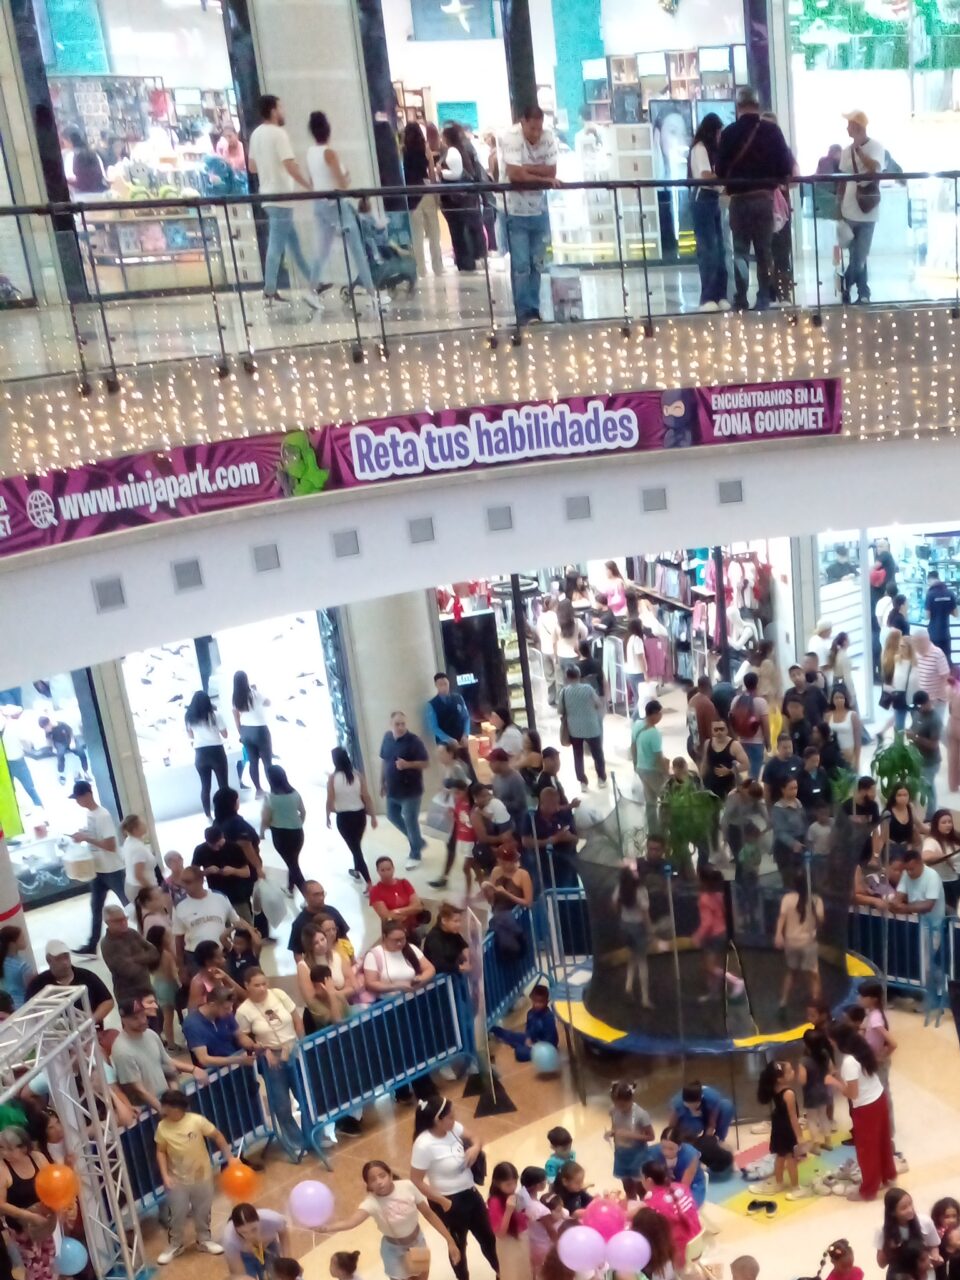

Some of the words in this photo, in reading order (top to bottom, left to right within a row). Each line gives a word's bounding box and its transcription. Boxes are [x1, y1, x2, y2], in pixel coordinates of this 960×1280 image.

[711, 388, 793, 411] ENCUÉNTRANOS
[794, 387, 808, 404] EN
[810, 386, 824, 404] LA
[354, 432, 420, 474] Reta
[424, 429, 471, 465] tus
[474, 406, 635, 457] habilidades
[712, 411, 752, 437] ZONA
[754, 407, 825, 433] GOURMET
[58, 461, 260, 521] www.ninjapark.com
